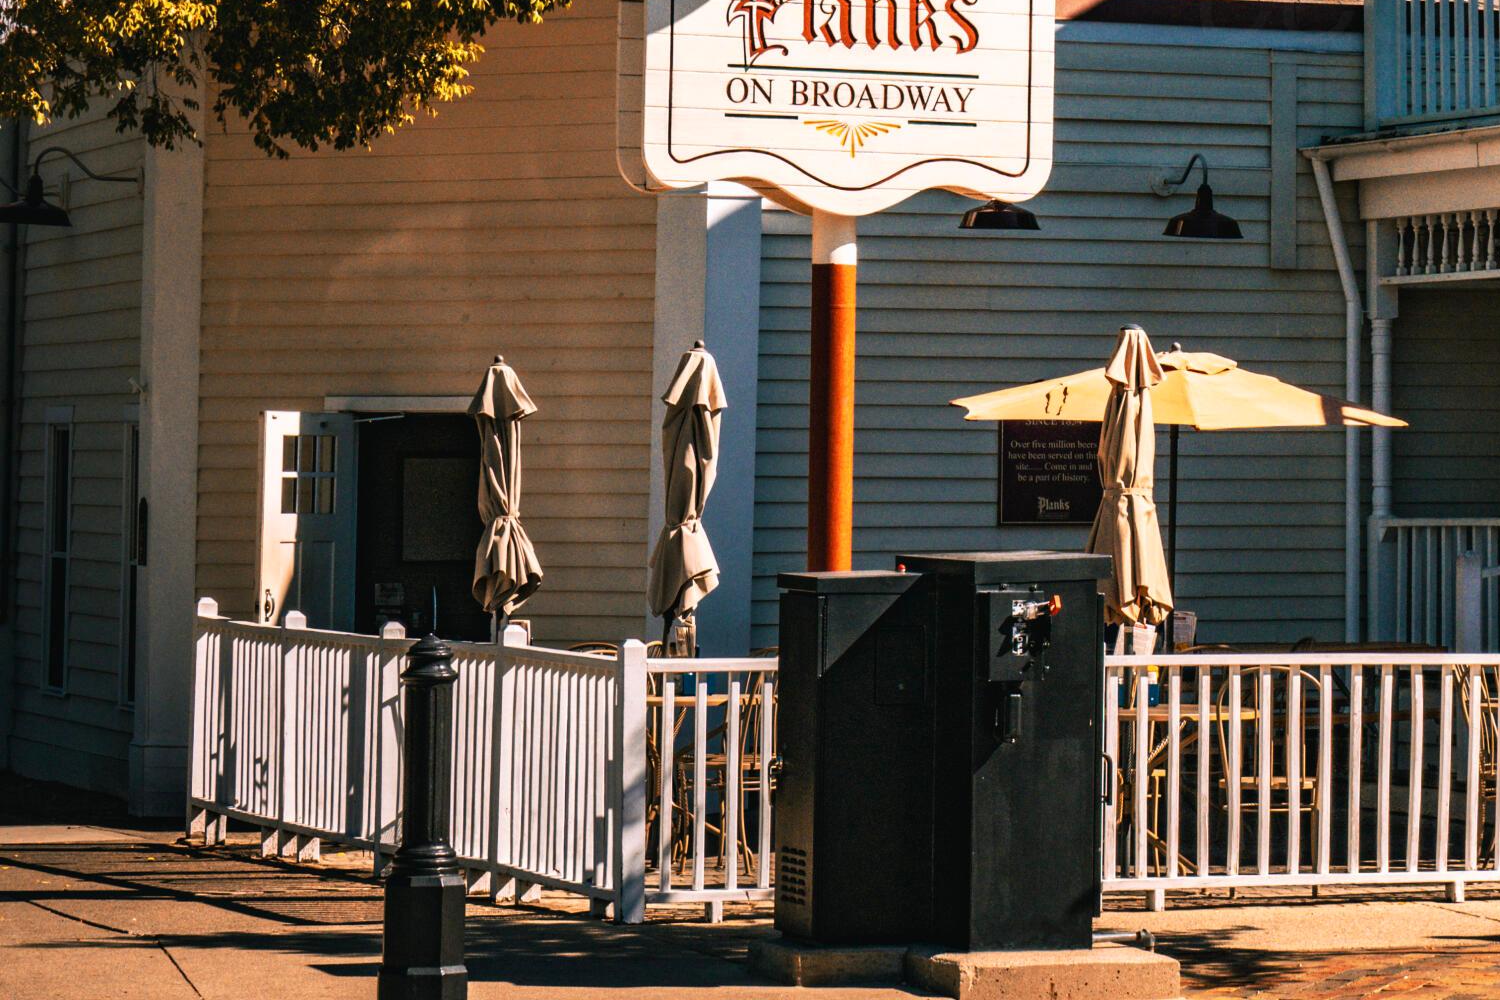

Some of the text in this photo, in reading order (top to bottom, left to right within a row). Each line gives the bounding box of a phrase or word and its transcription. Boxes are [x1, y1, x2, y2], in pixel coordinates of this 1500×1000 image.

[726, 77, 974, 113] ON BROADWAY
[1010, 440, 1030, 449] Over
[1032, 440, 1047, 449] five
[1048, 440, 1076, 449] million
[1008, 451, 1026, 460] have
[1028, 451, 1046, 460] been
[1047, 451, 1072, 460] served
[1044, 462, 1066, 471] Come
[1079, 462, 1093, 471] and
[1017, 473, 1028, 482] be
[1035, 473, 1050, 483] part
[1052, 473, 1061, 482] of
